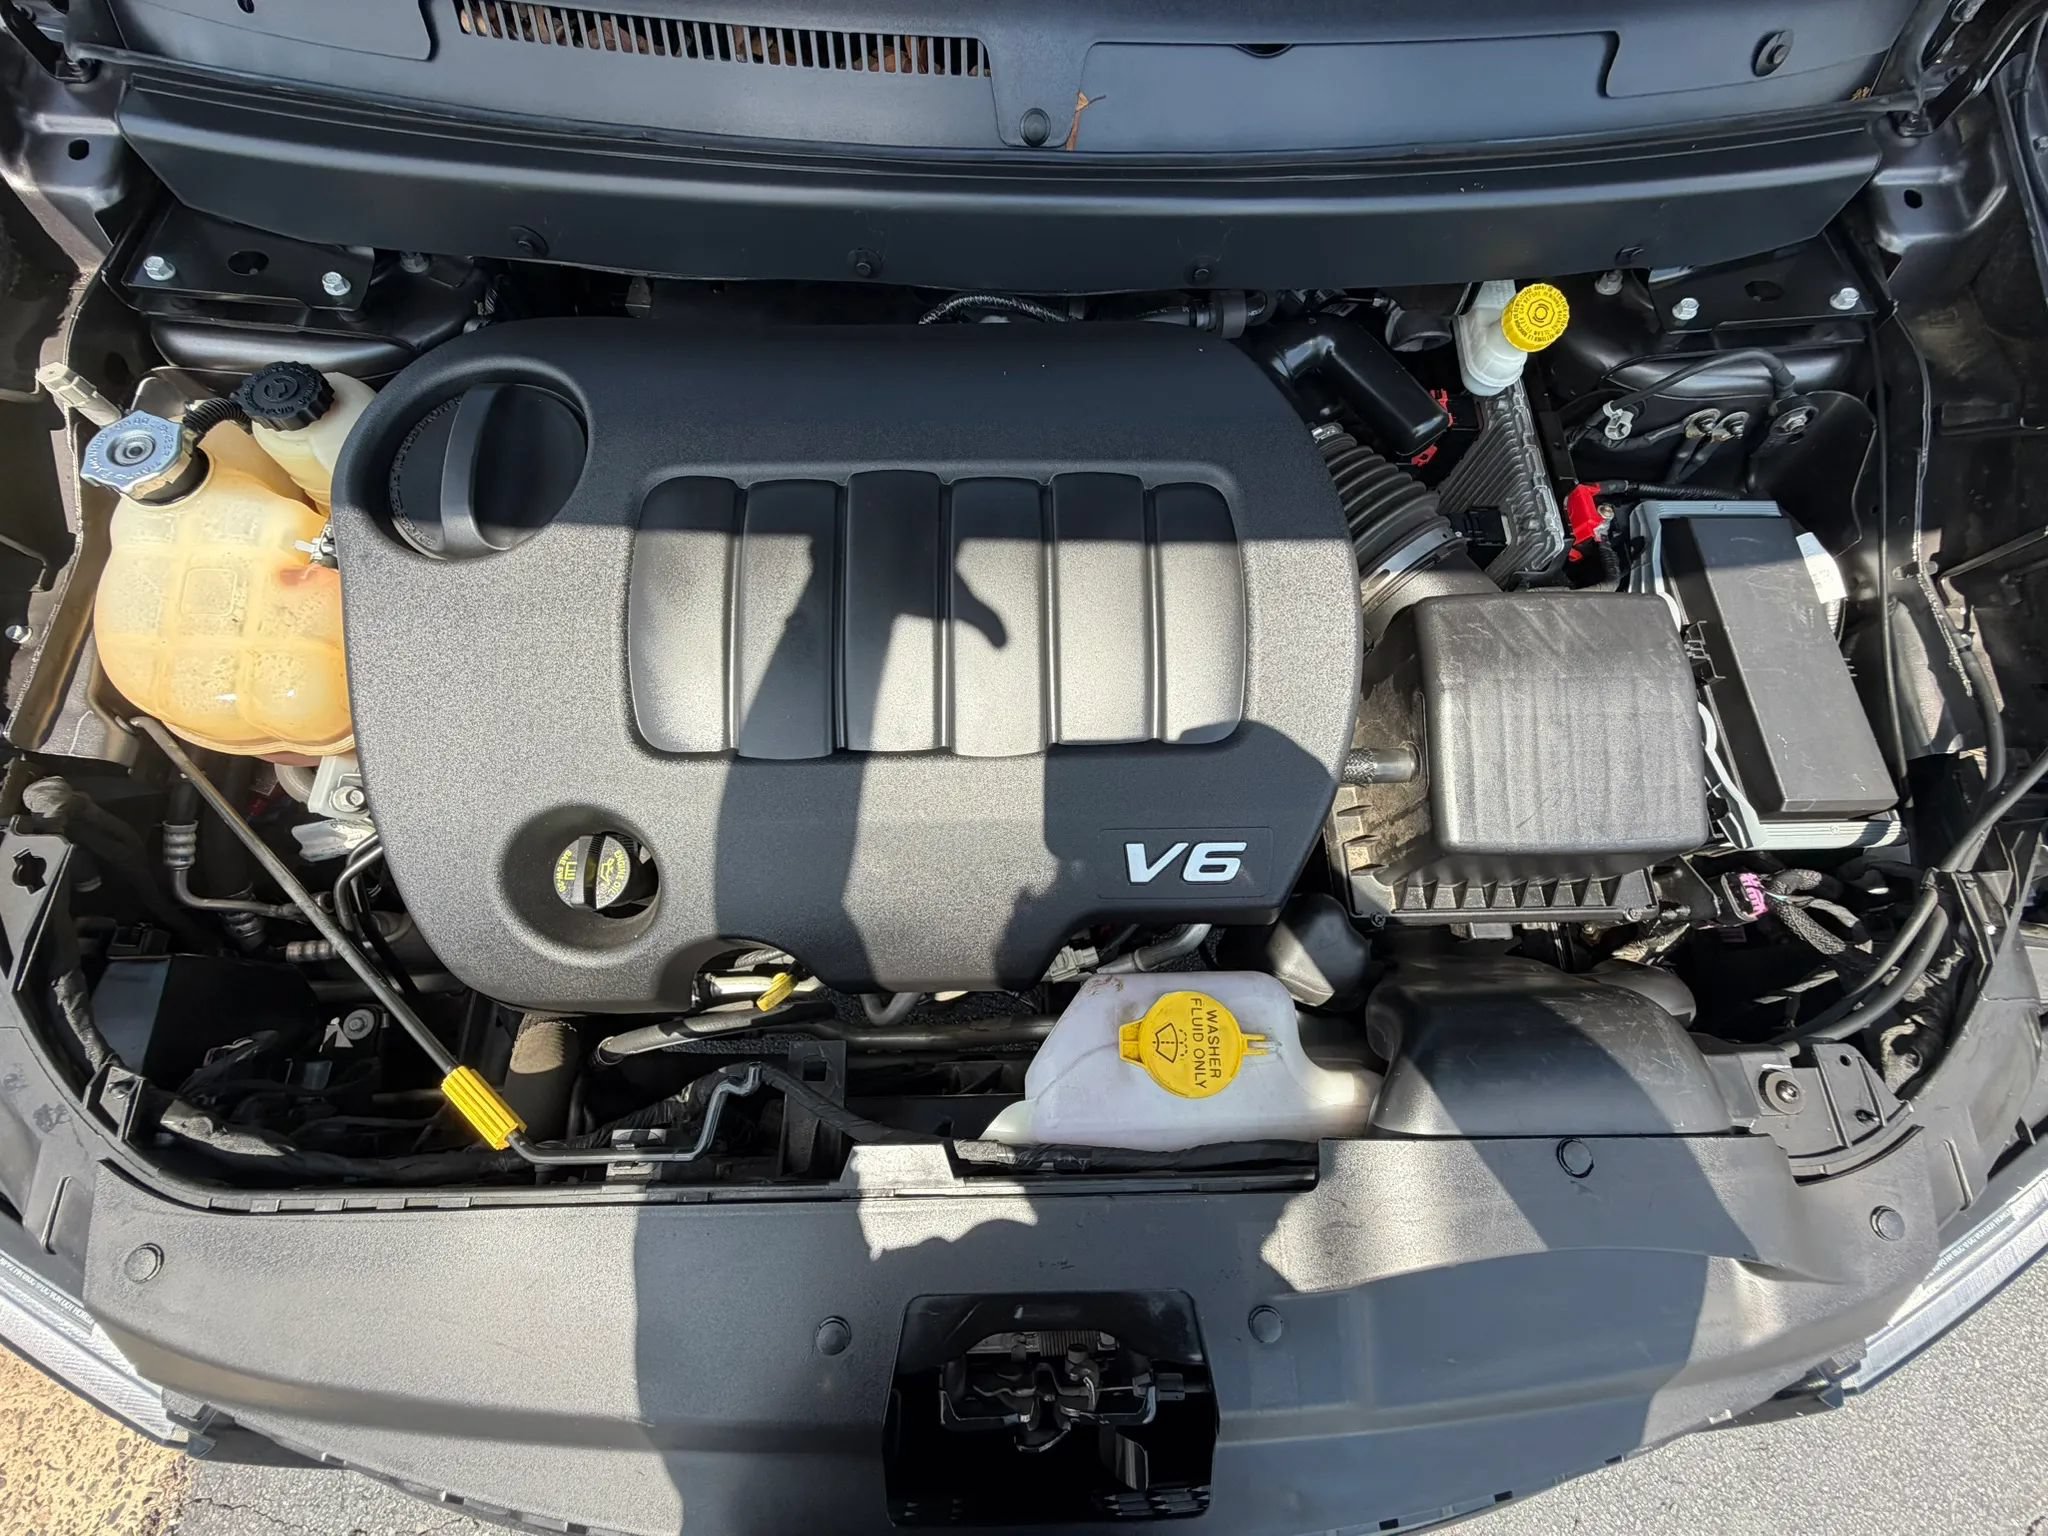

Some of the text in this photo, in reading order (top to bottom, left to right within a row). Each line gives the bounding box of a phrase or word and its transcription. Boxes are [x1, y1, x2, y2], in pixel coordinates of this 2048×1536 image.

[559, 849, 573, 866] SAE
[608, 849, 626, 896] ENGINE OIL
[1124, 841, 1248, 883] V6
[1190, 997, 1208, 1089] FLUID ONLY
[1206, 1009, 1222, 1079] WASHER
